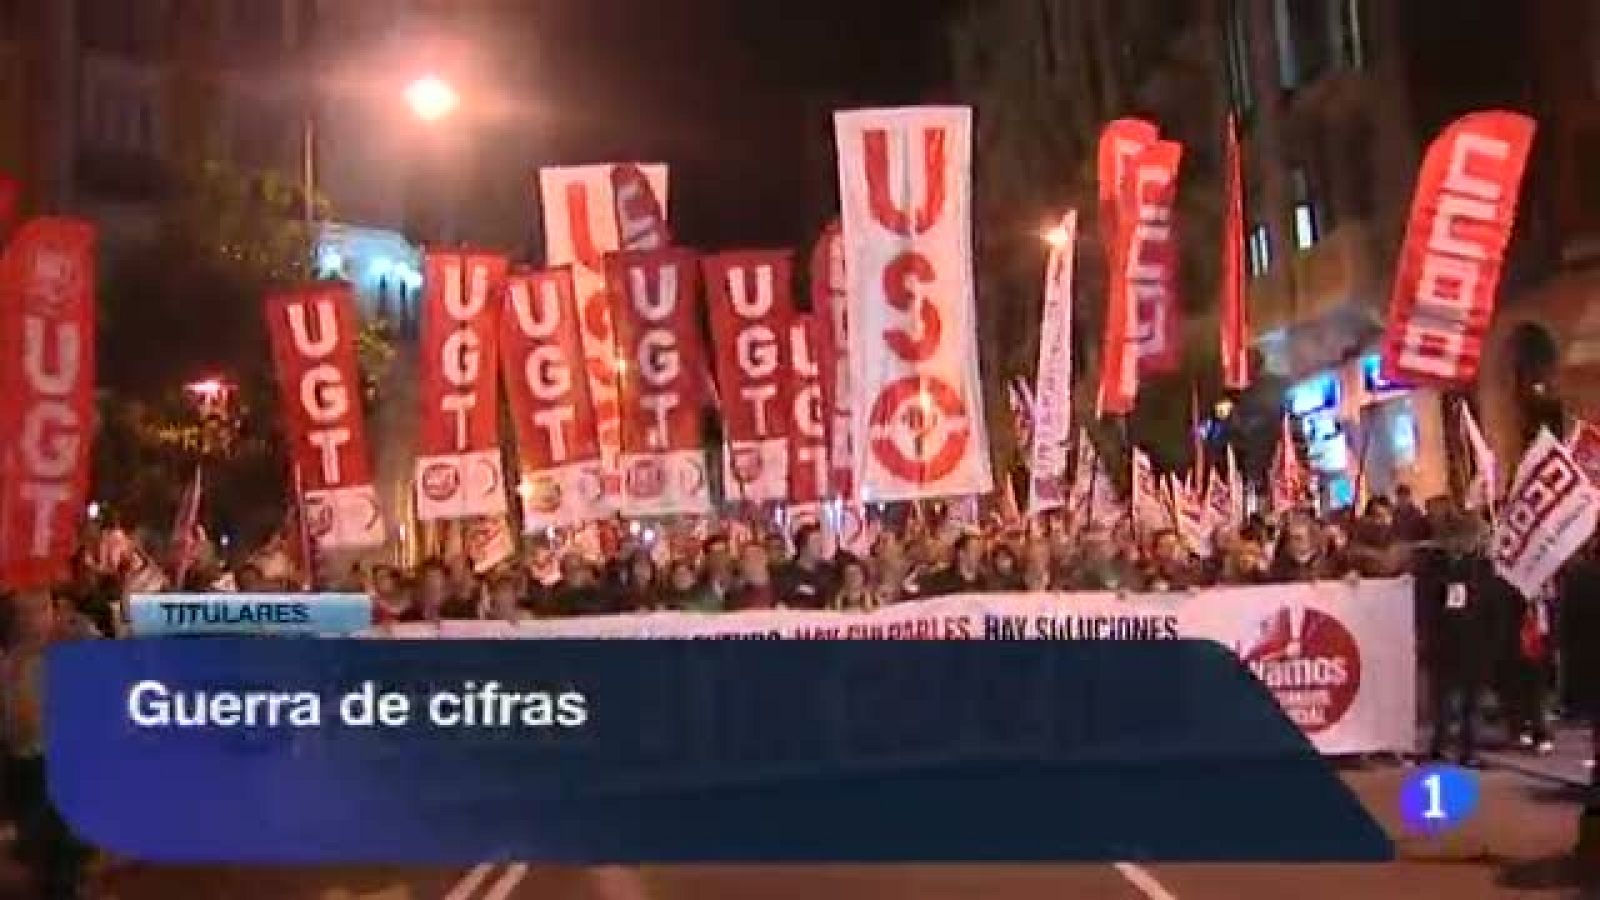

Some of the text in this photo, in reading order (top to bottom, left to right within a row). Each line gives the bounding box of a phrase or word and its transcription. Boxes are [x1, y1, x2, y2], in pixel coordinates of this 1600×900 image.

[287, 300, 352, 485] UGT
[441, 260, 488, 450] UGT
[510, 280, 575, 462] UGT
[630, 264, 680, 448] UGT
[726, 265, 778, 438] UGT
[862, 127, 970, 483] USO
[20, 317, 81, 556] UGT
